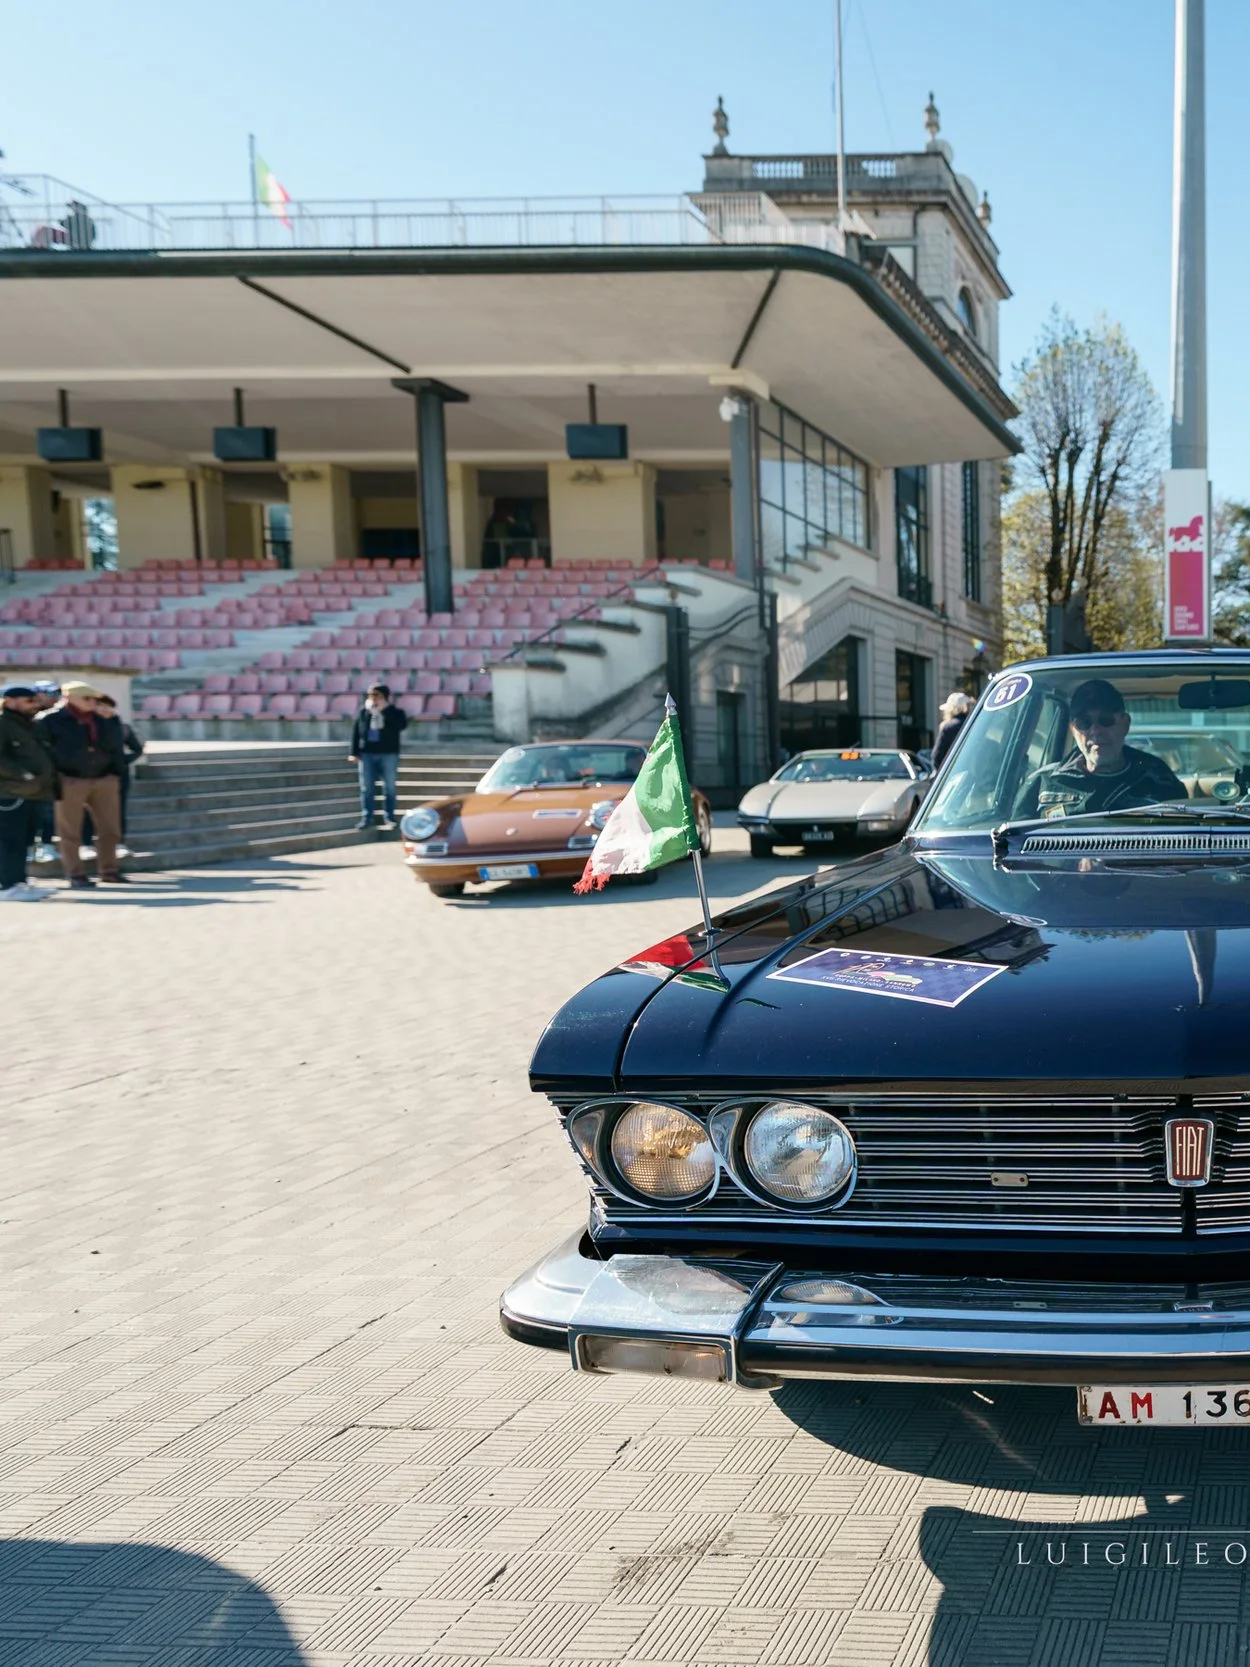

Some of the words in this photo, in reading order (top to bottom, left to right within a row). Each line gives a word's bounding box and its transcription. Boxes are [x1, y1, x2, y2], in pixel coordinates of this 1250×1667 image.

[994, 684, 1017, 704] 61
[1176, 1126, 1205, 1176] FIAT
[1098, 1391, 1154, 1419] AM
